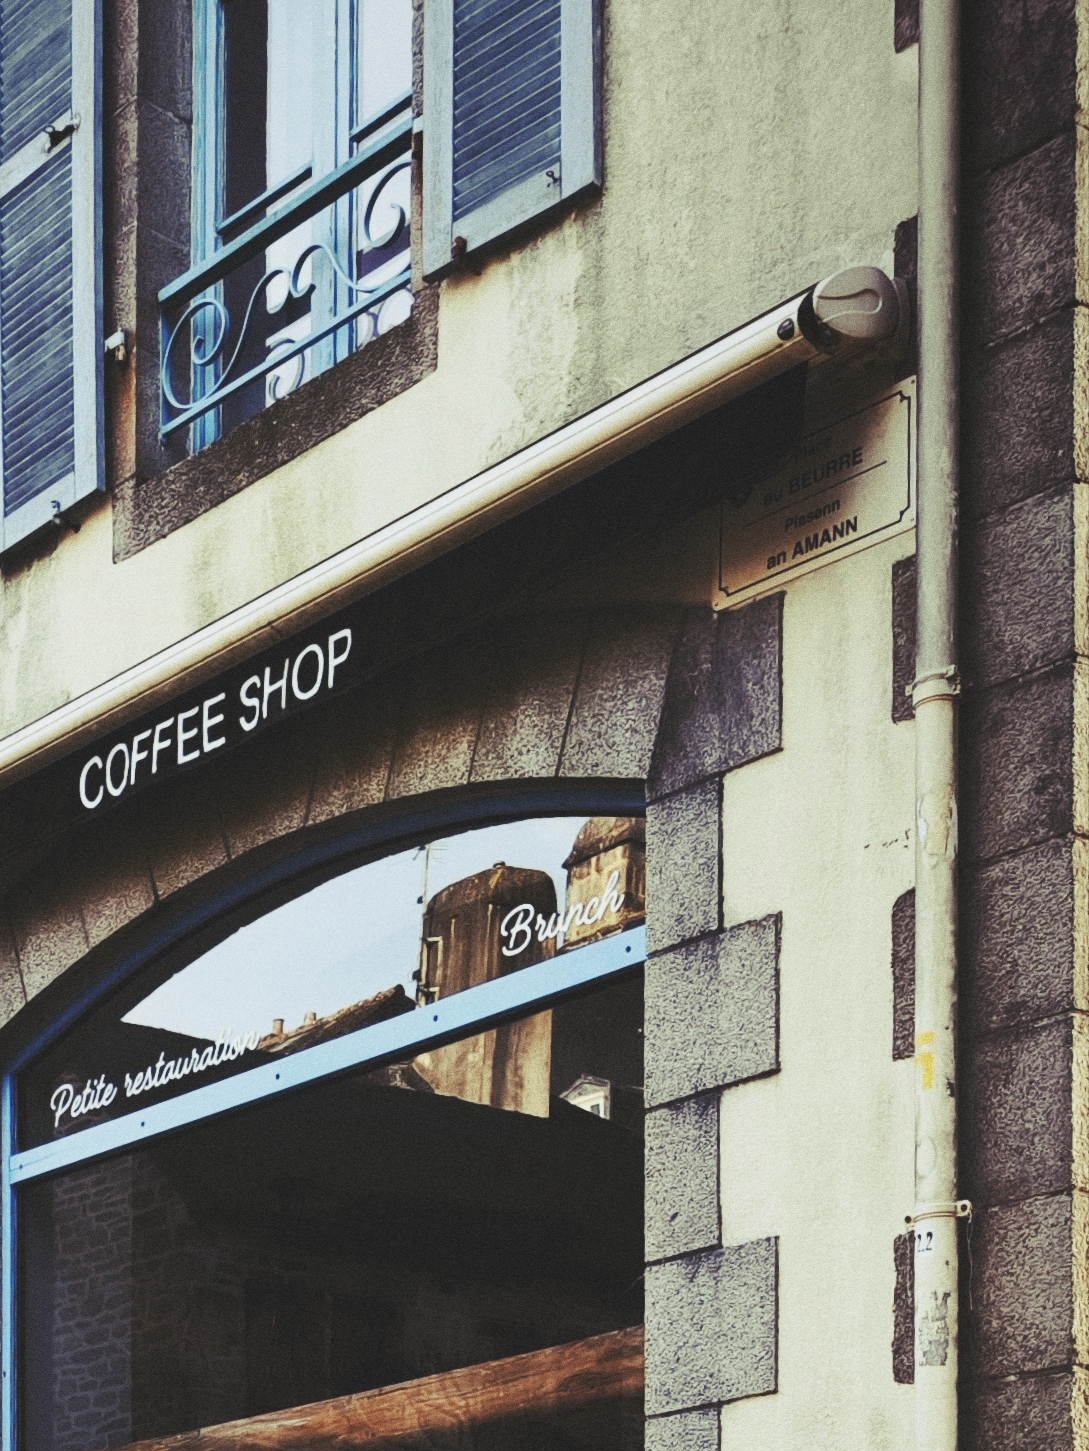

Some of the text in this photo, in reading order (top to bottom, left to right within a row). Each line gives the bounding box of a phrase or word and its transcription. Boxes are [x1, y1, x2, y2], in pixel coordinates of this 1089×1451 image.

[789, 446, 864, 495] BEURRE
[766, 515, 858, 570] an AMANN
[79, 628, 352, 809] COFFEE SHOP
[500, 870, 625, 957] Brunch
[50, 1027, 261, 1128] Petite restauration
